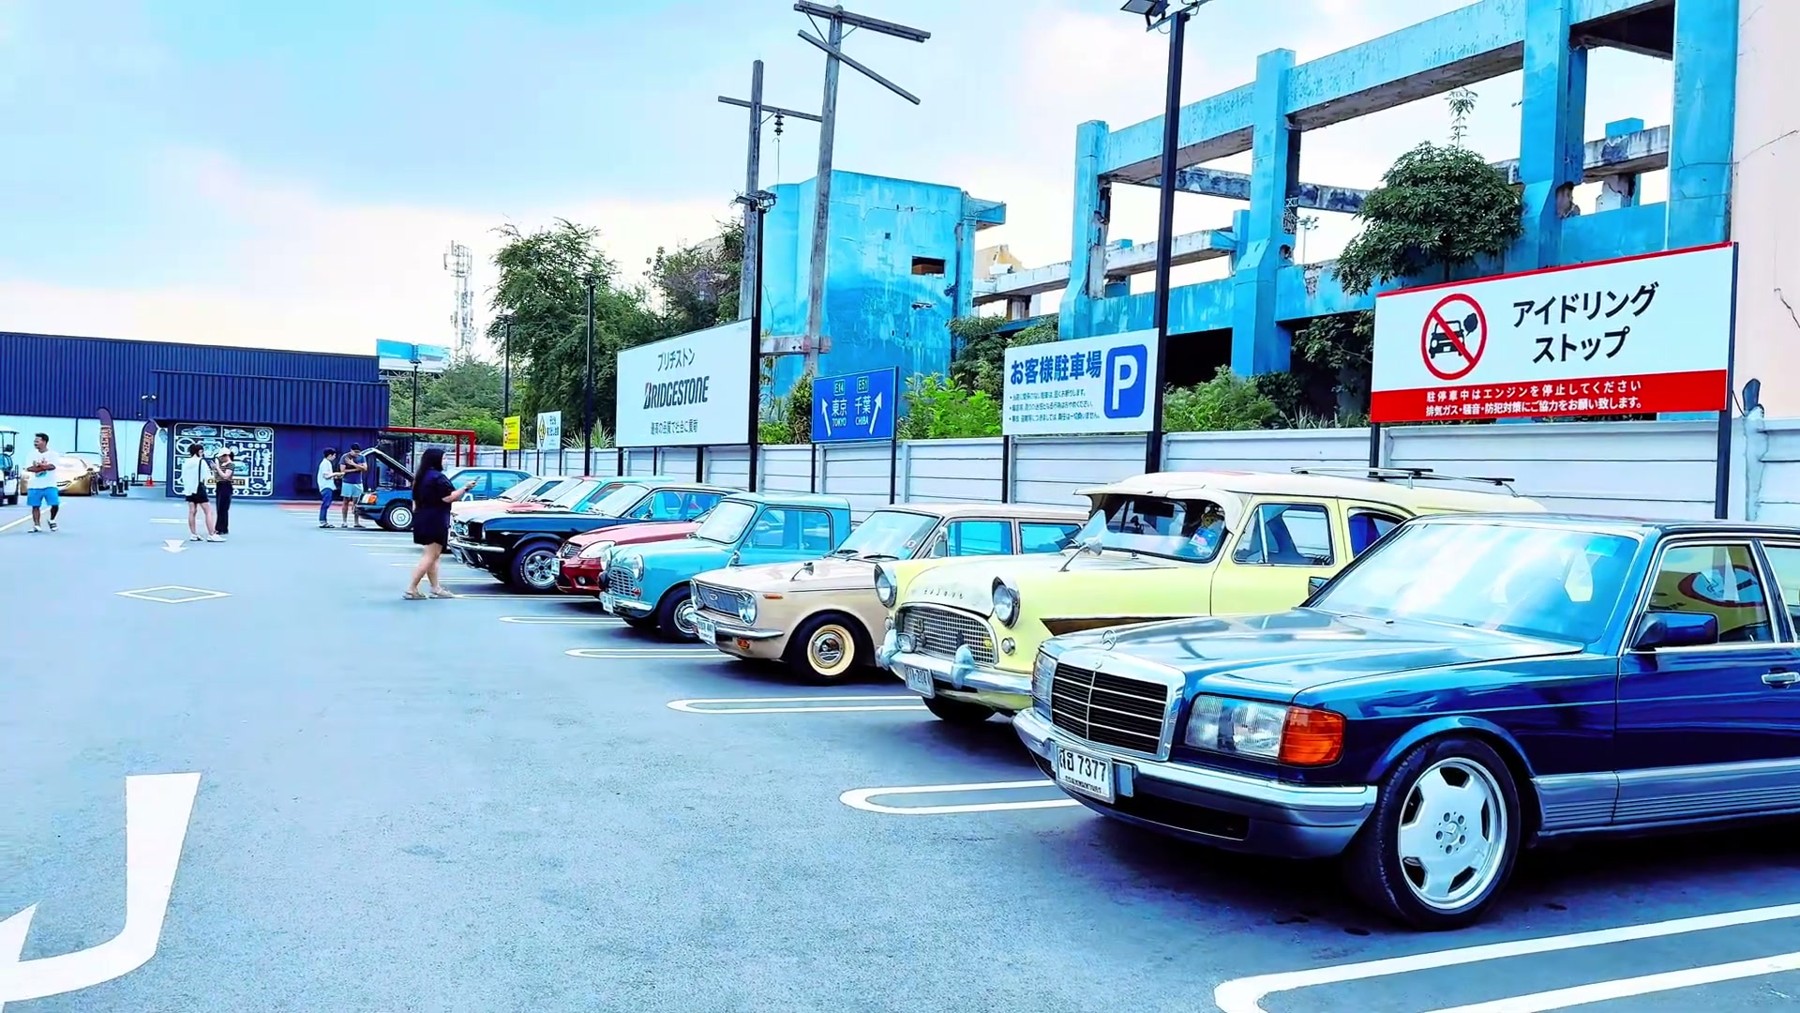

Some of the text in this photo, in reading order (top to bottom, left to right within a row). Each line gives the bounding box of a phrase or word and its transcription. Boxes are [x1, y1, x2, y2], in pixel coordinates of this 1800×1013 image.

[1513, 281, 1659, 328] アイドリング
[1532, 325, 1631, 364] ストップ
[1010, 350, 1102, 385] お客様駐車場
[1112, 354, 1139, 411] P
[643, 375, 710, 410] BRIDGESTONE
[831, 397, 848, 417] 東京
[854, 395, 871, 415] 千葉
[832, 417, 847, 427] TOKYO
[855, 416, 869, 426] CHIBA
[1077, 754, 1107, 782] 7377
